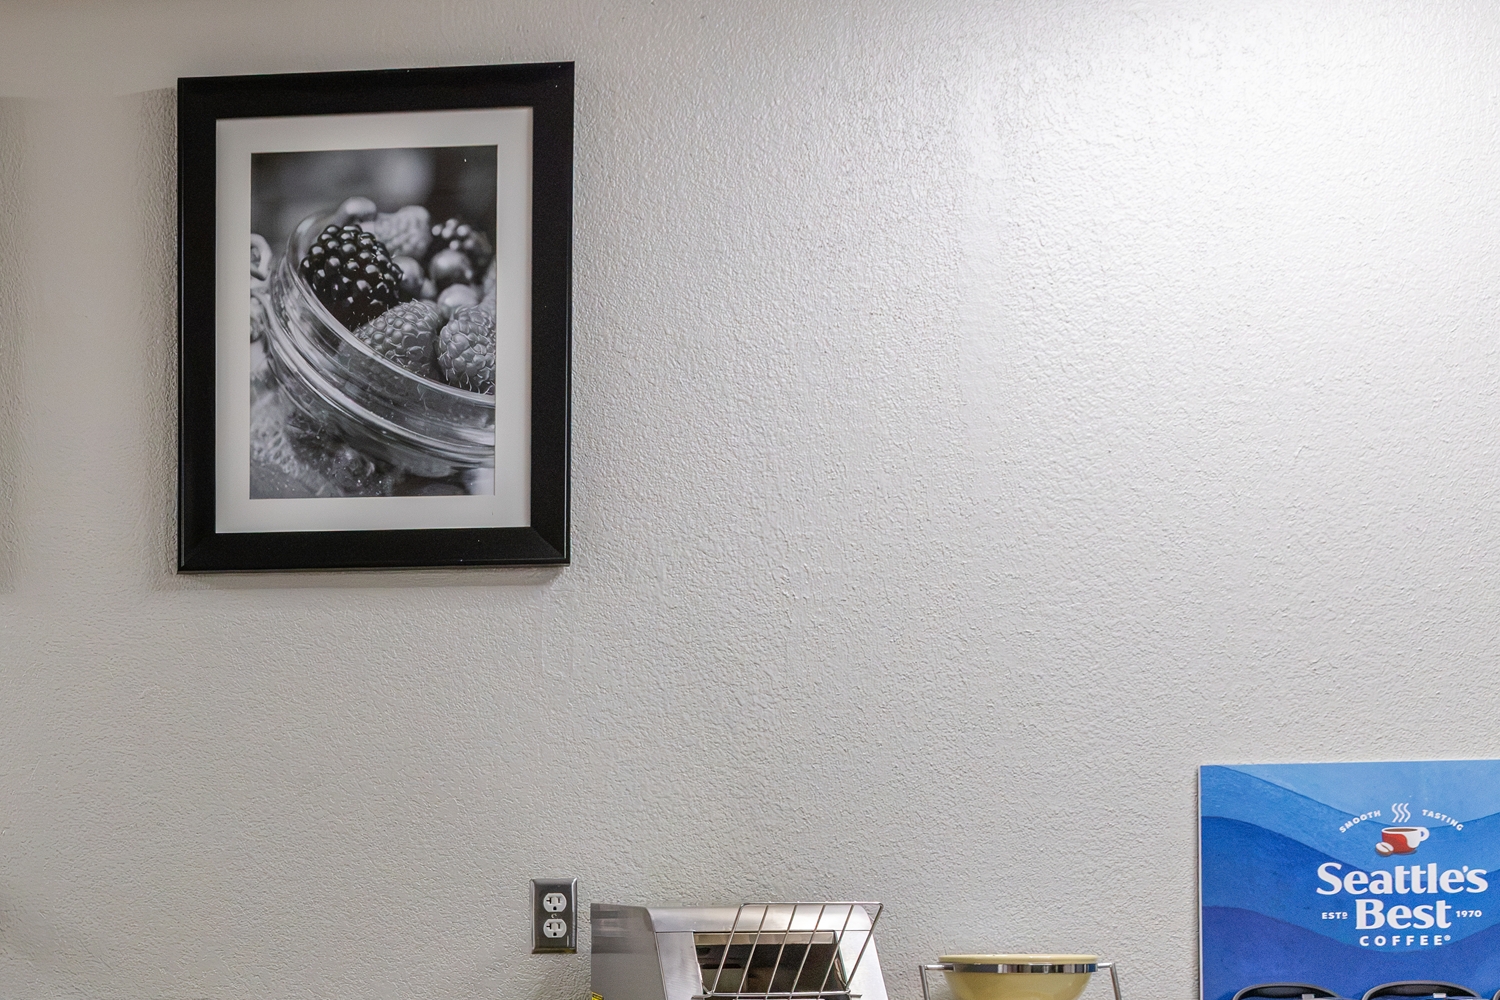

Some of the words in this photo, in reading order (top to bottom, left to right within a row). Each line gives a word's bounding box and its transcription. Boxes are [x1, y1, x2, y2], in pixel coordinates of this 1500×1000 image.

[1339, 810, 1382, 833] SMOOTH
[1422, 809, 1464, 831] TASTING
[1316, 862, 1489, 896] Seattle's
[1355, 899, 1452, 930] Best
[1456, 910, 1483, 918] 1970
